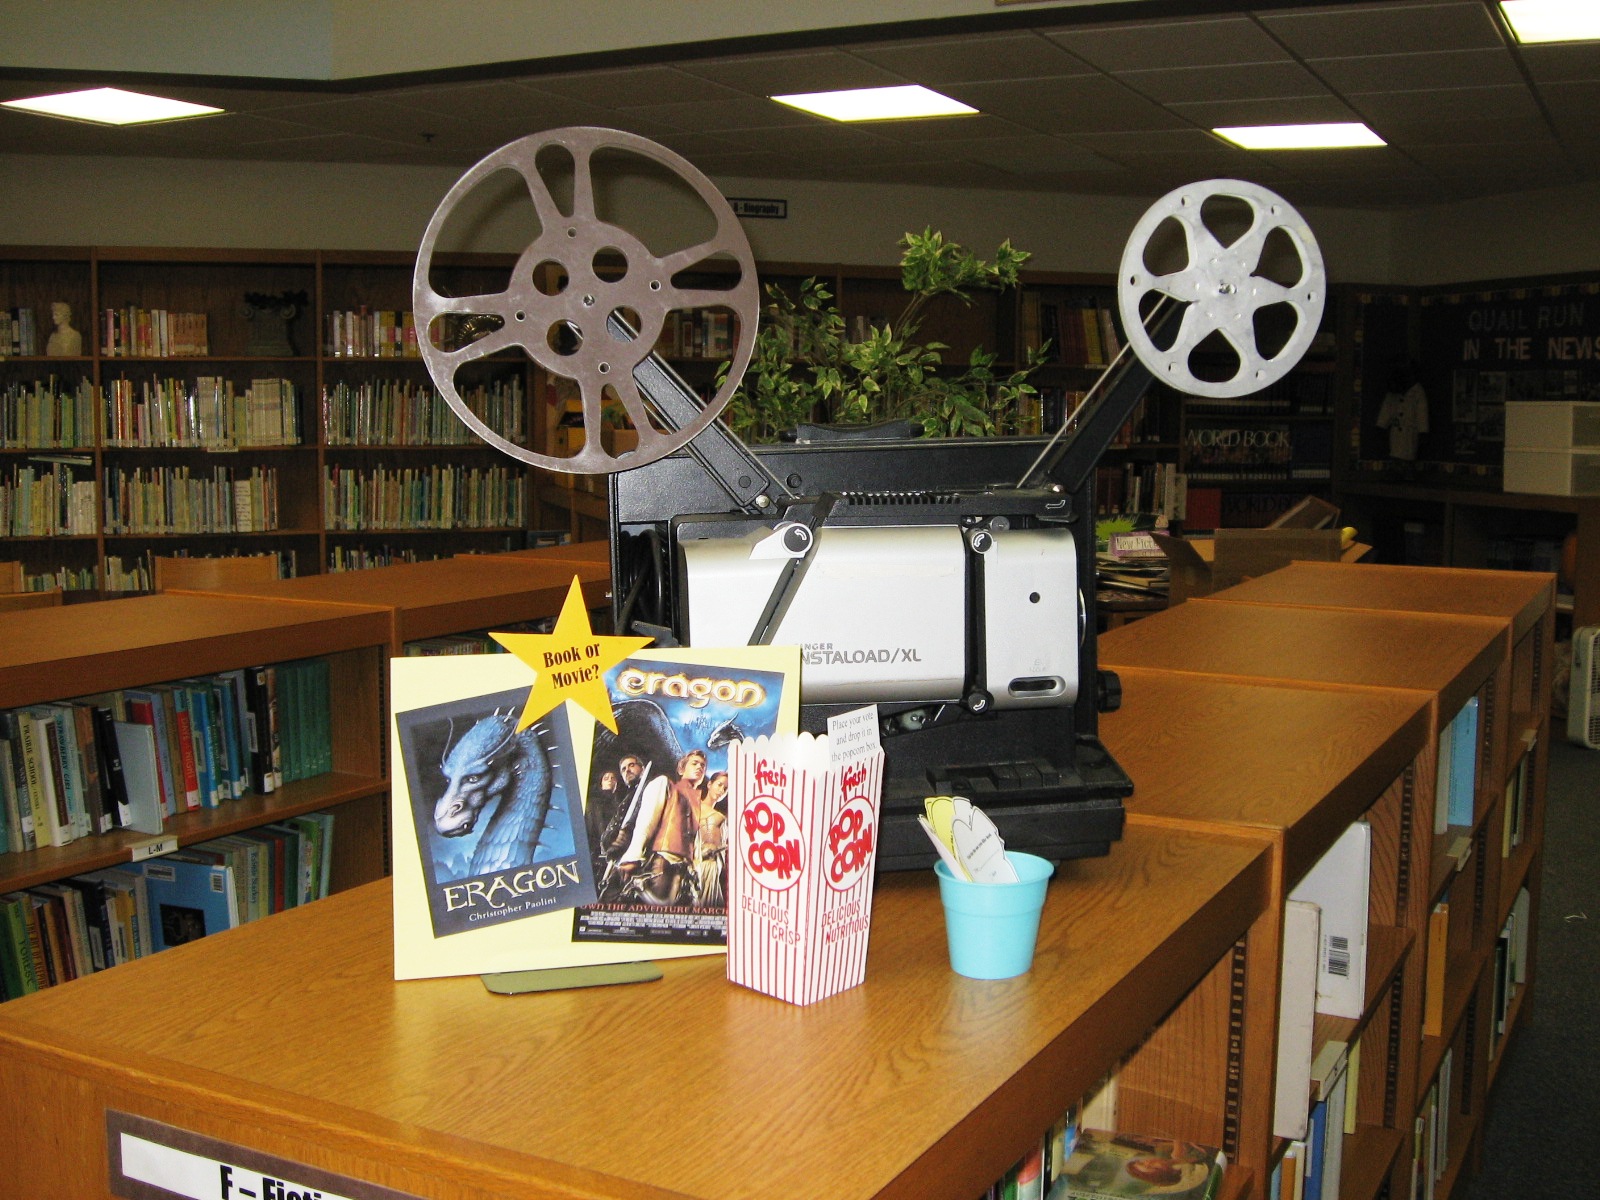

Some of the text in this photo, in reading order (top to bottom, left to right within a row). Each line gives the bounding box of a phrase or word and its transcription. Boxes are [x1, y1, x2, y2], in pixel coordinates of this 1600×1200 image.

[1467, 302, 1585, 332] QUAIL RUN
[1463, 336, 1600, 361] IN THE NEWS
[1185, 429, 1291, 448] WORLD BOOK
[543, 643, 601, 669] Book or
[801, 648, 922, 665] NSTALOAD/XL
[551, 664, 600, 690] Movie?
[620, 667, 766, 709] eragon
[832, 712, 874, 731] Place your vote
[836, 733, 847, 745] and
[848, 731, 860, 742] drop
[831, 752, 841, 762] the
[842, 746, 866, 762] popcorn
[755, 758, 787, 794] fresh
[841, 765, 868, 803] fresh
[743, 801, 786, 844] POP
[829, 807, 864, 856] POP
[148, 843, 163, 855] L-M
[747, 838, 802, 881] CORN
[830, 823, 874, 884] CORN
[443, 861, 580, 912] ERAGON
[469, 896, 557, 922] Christopher Paolini
[607, 903, 626, 911] THE
[628, 904, 689, 914] ADVENTURE
[741, 894, 790, 926] DELICIOUS
[820, 897, 862, 929] DELICIOUS
[771, 921, 802, 947] CRISP
[824, 914, 870, 946] NUTRITIOUS
[220, 1165, 233, 1200] F
